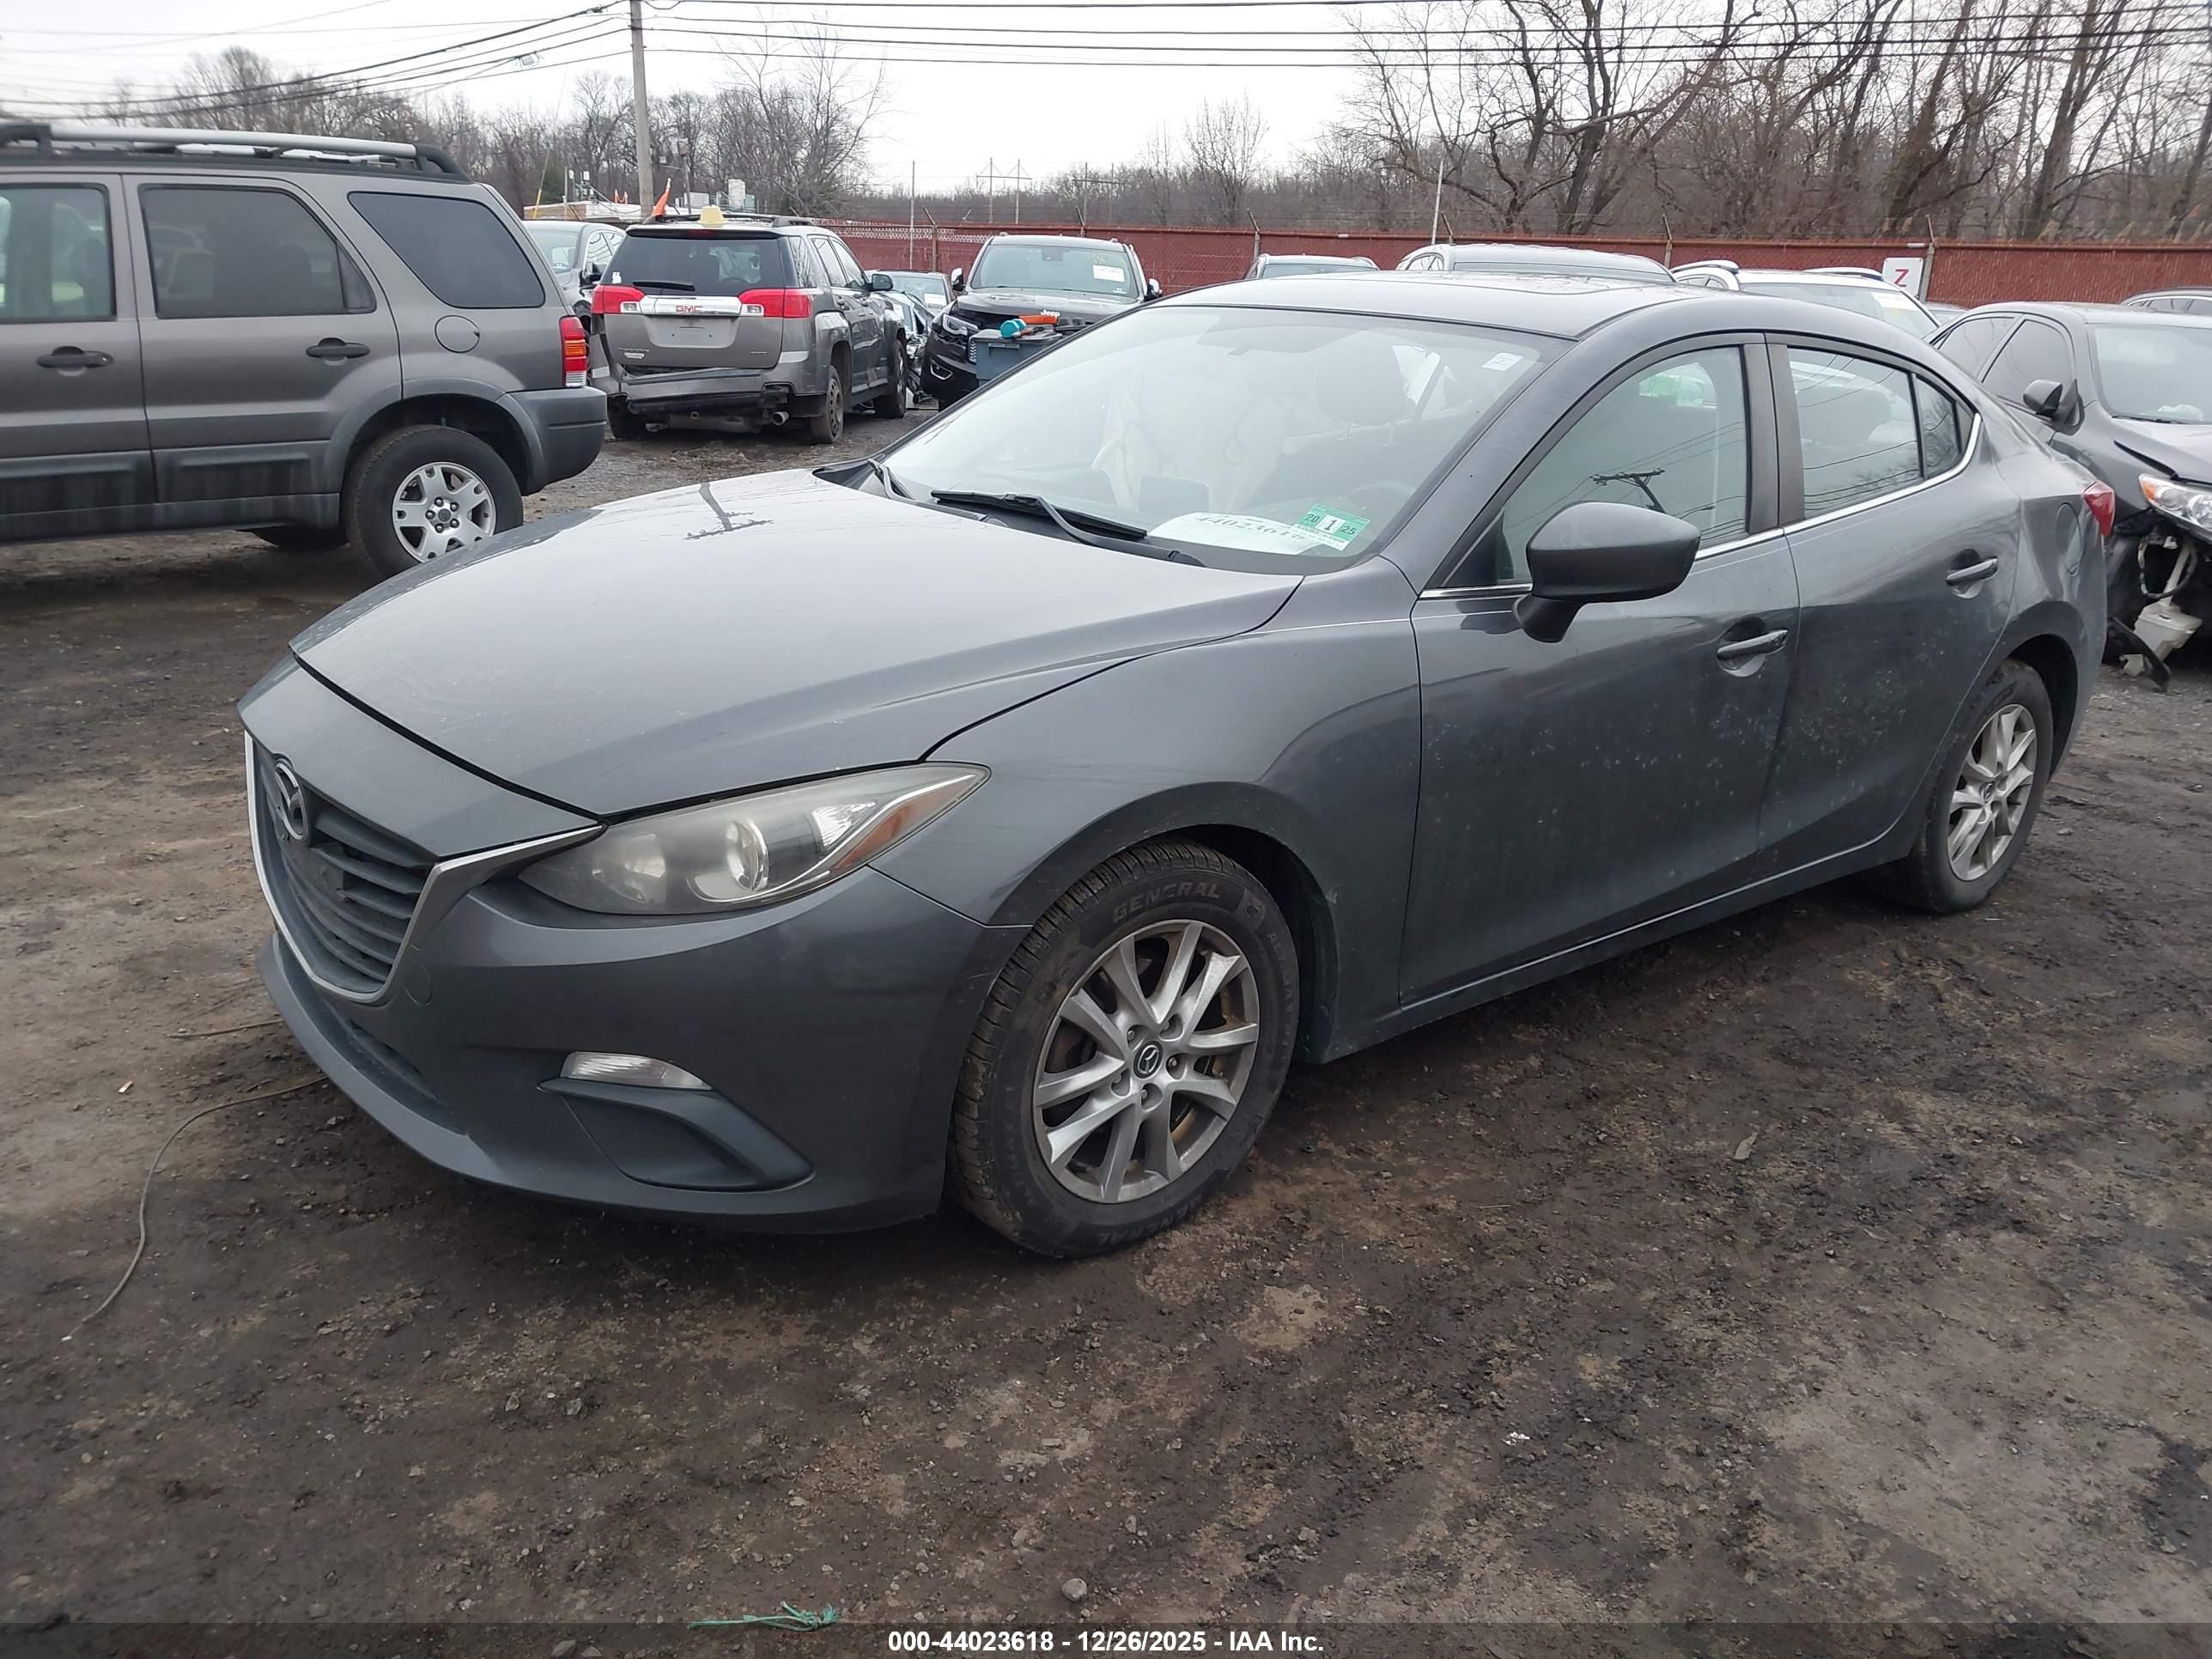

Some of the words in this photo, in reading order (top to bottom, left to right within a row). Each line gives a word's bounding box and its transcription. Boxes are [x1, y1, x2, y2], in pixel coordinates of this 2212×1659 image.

[1894, 269, 1910, 288] Z
[1304, 514, 1321, 523] 20
[1323, 519, 1338, 531] 1
[1340, 525, 1358, 536] 25
[1113, 881, 1219, 922] GENERAL
